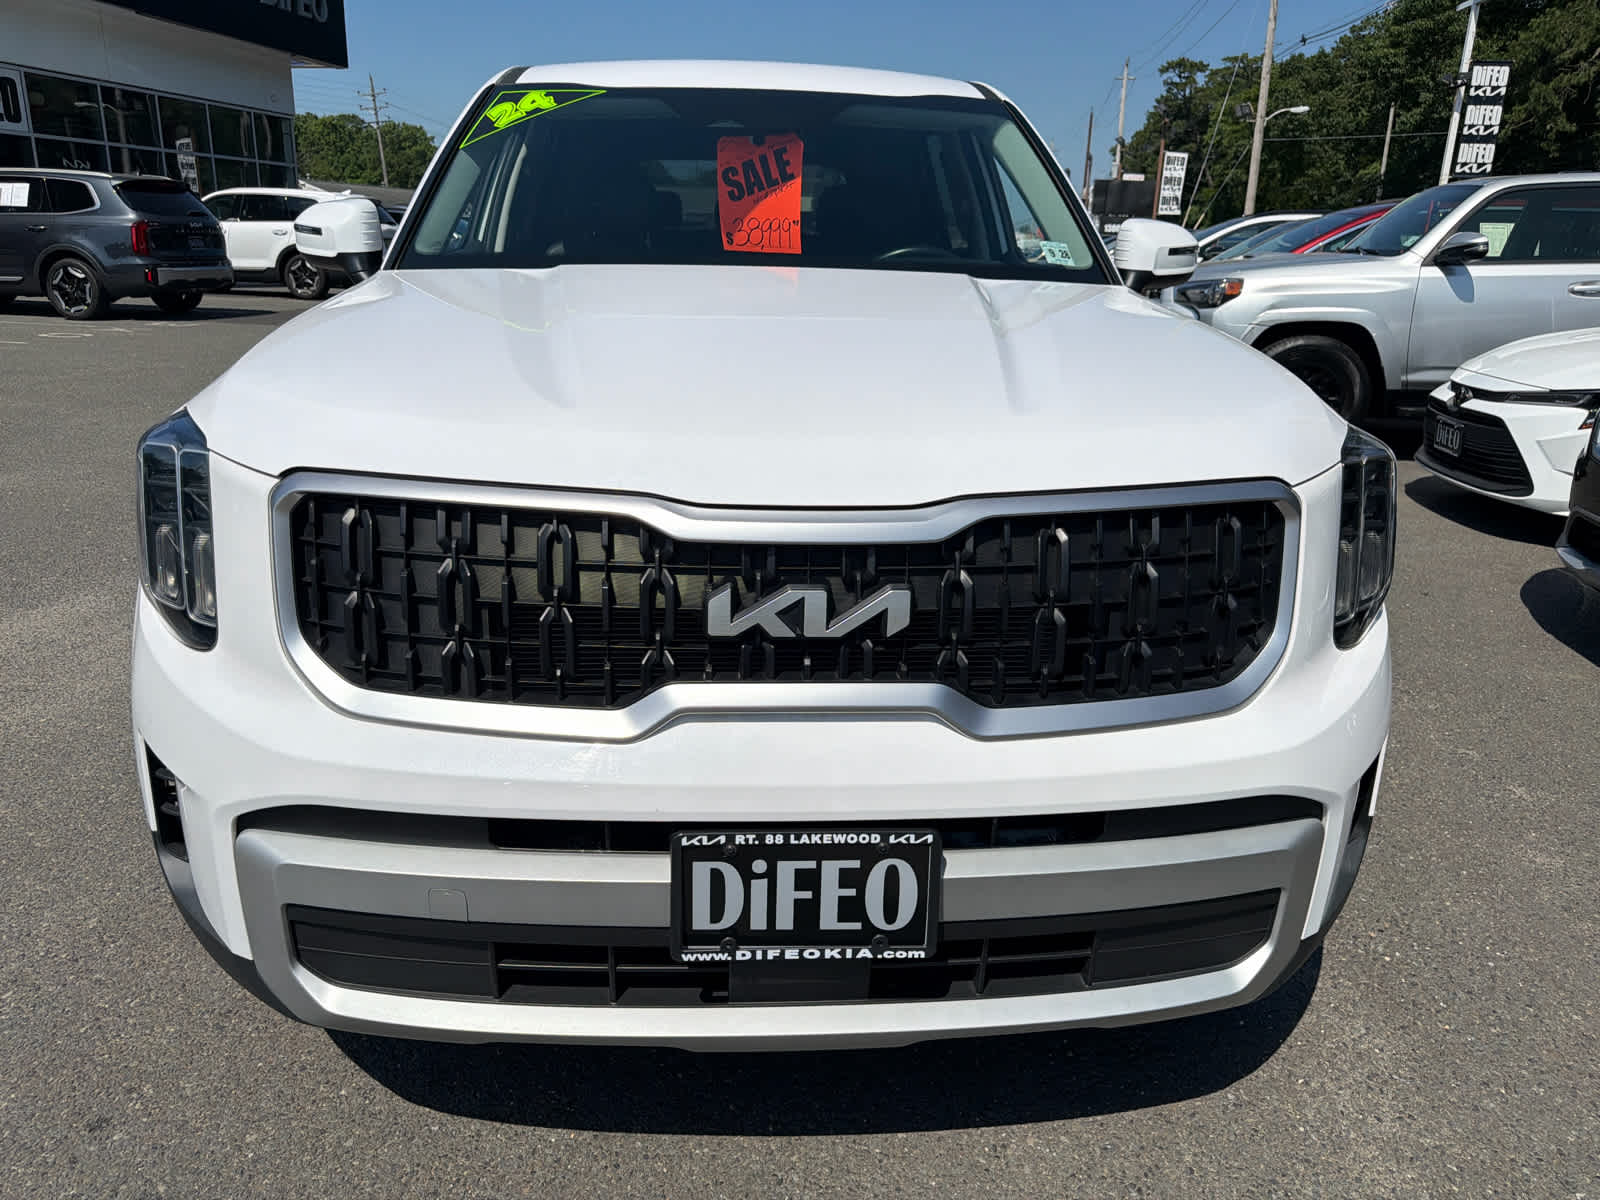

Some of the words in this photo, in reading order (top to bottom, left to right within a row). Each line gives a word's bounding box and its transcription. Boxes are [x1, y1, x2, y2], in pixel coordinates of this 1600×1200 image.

[1469, 86, 1507, 96] KIA
[486, 91, 557, 128] 24
[1462, 125, 1499, 135] KIA
[722, 145, 794, 201] SALE
[1455, 163, 1493, 173] KIA
[707, 584, 911, 637] KIA
[681, 835, 726, 846] KIA
[735, 834, 759, 845] RT.
[765, 834, 784, 845] 88
[790, 833, 881, 845] LAKEWOOD
[889, 833, 933, 844] KIA
[692, 858, 919, 930] DiFEO
[681, 948, 926, 961] www.DIFEOKIA.com
